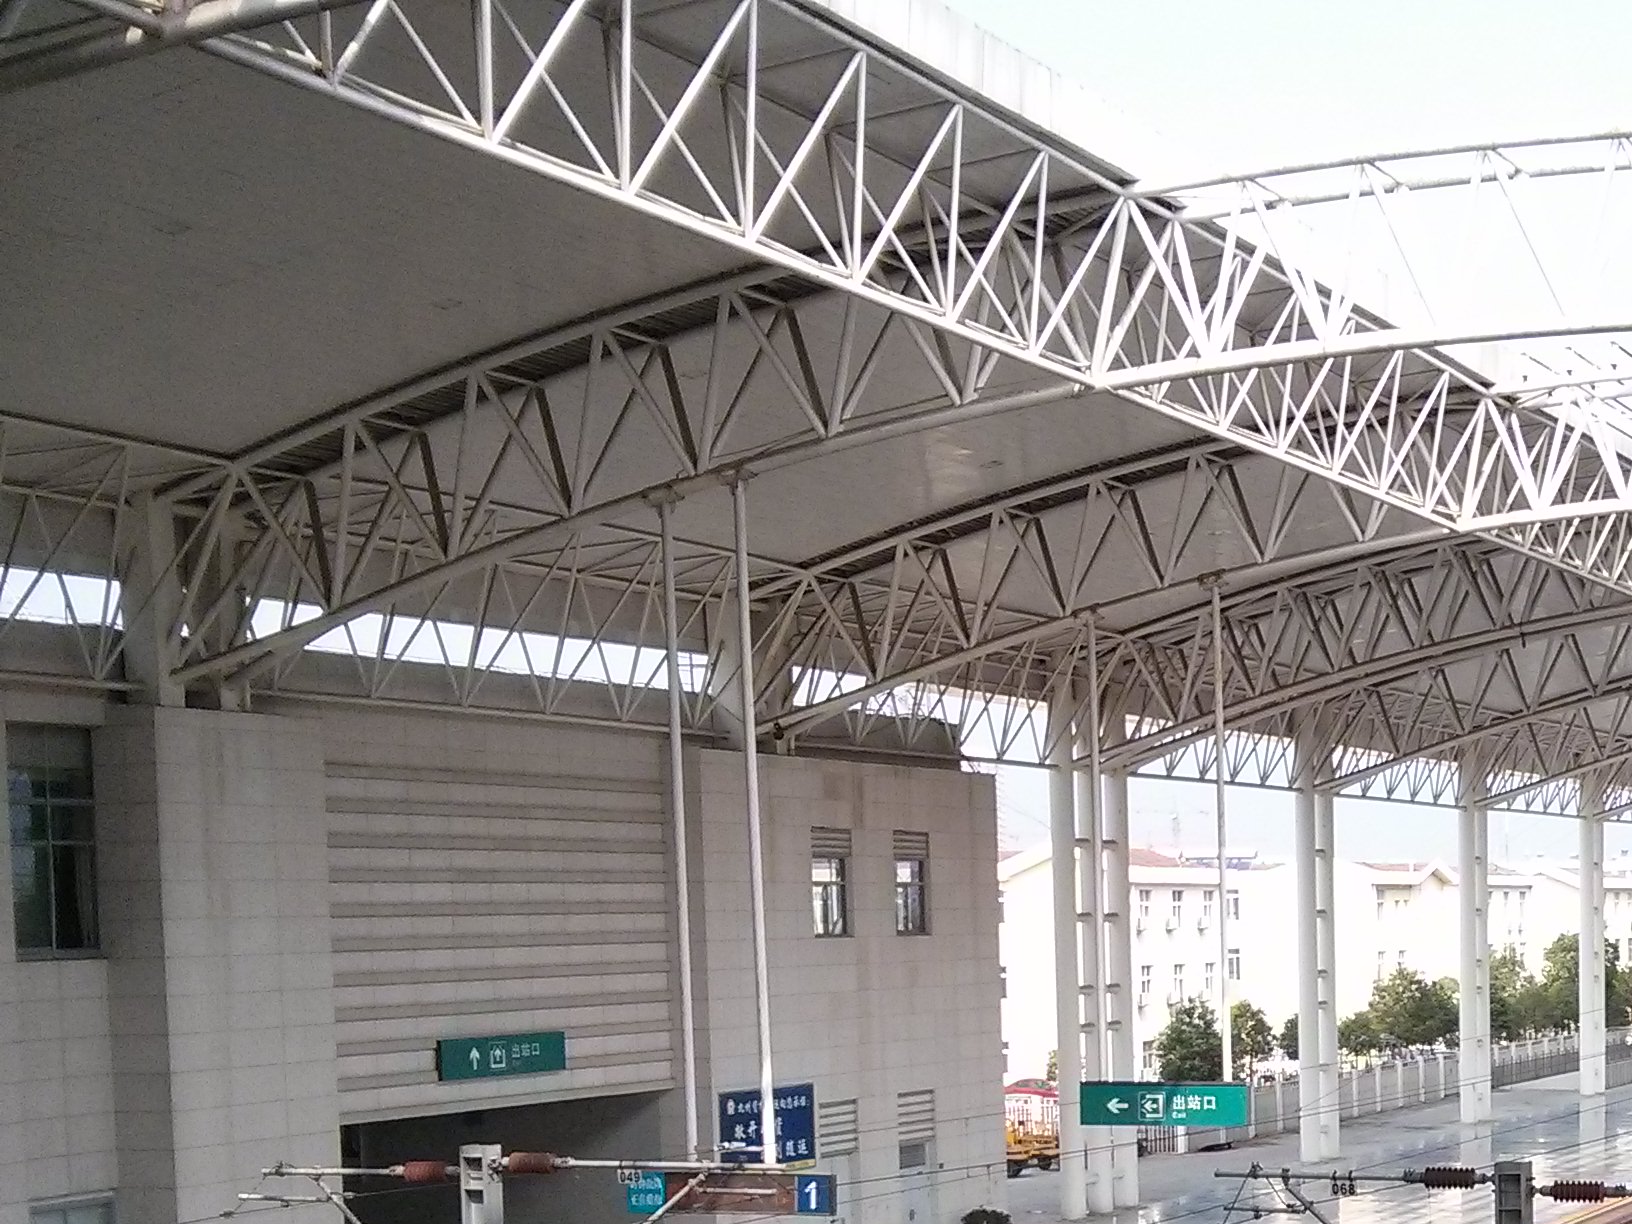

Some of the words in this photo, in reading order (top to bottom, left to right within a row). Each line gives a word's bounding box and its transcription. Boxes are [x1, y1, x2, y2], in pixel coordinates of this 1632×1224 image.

[512, 1043, 539, 1057] 出站口
[1172, 1094, 1216, 1111] 出站口
[620, 1171, 640, 1183] 049
[804, 1181, 816, 1210] 1
[1332, 1183, 1356, 1195] 068
